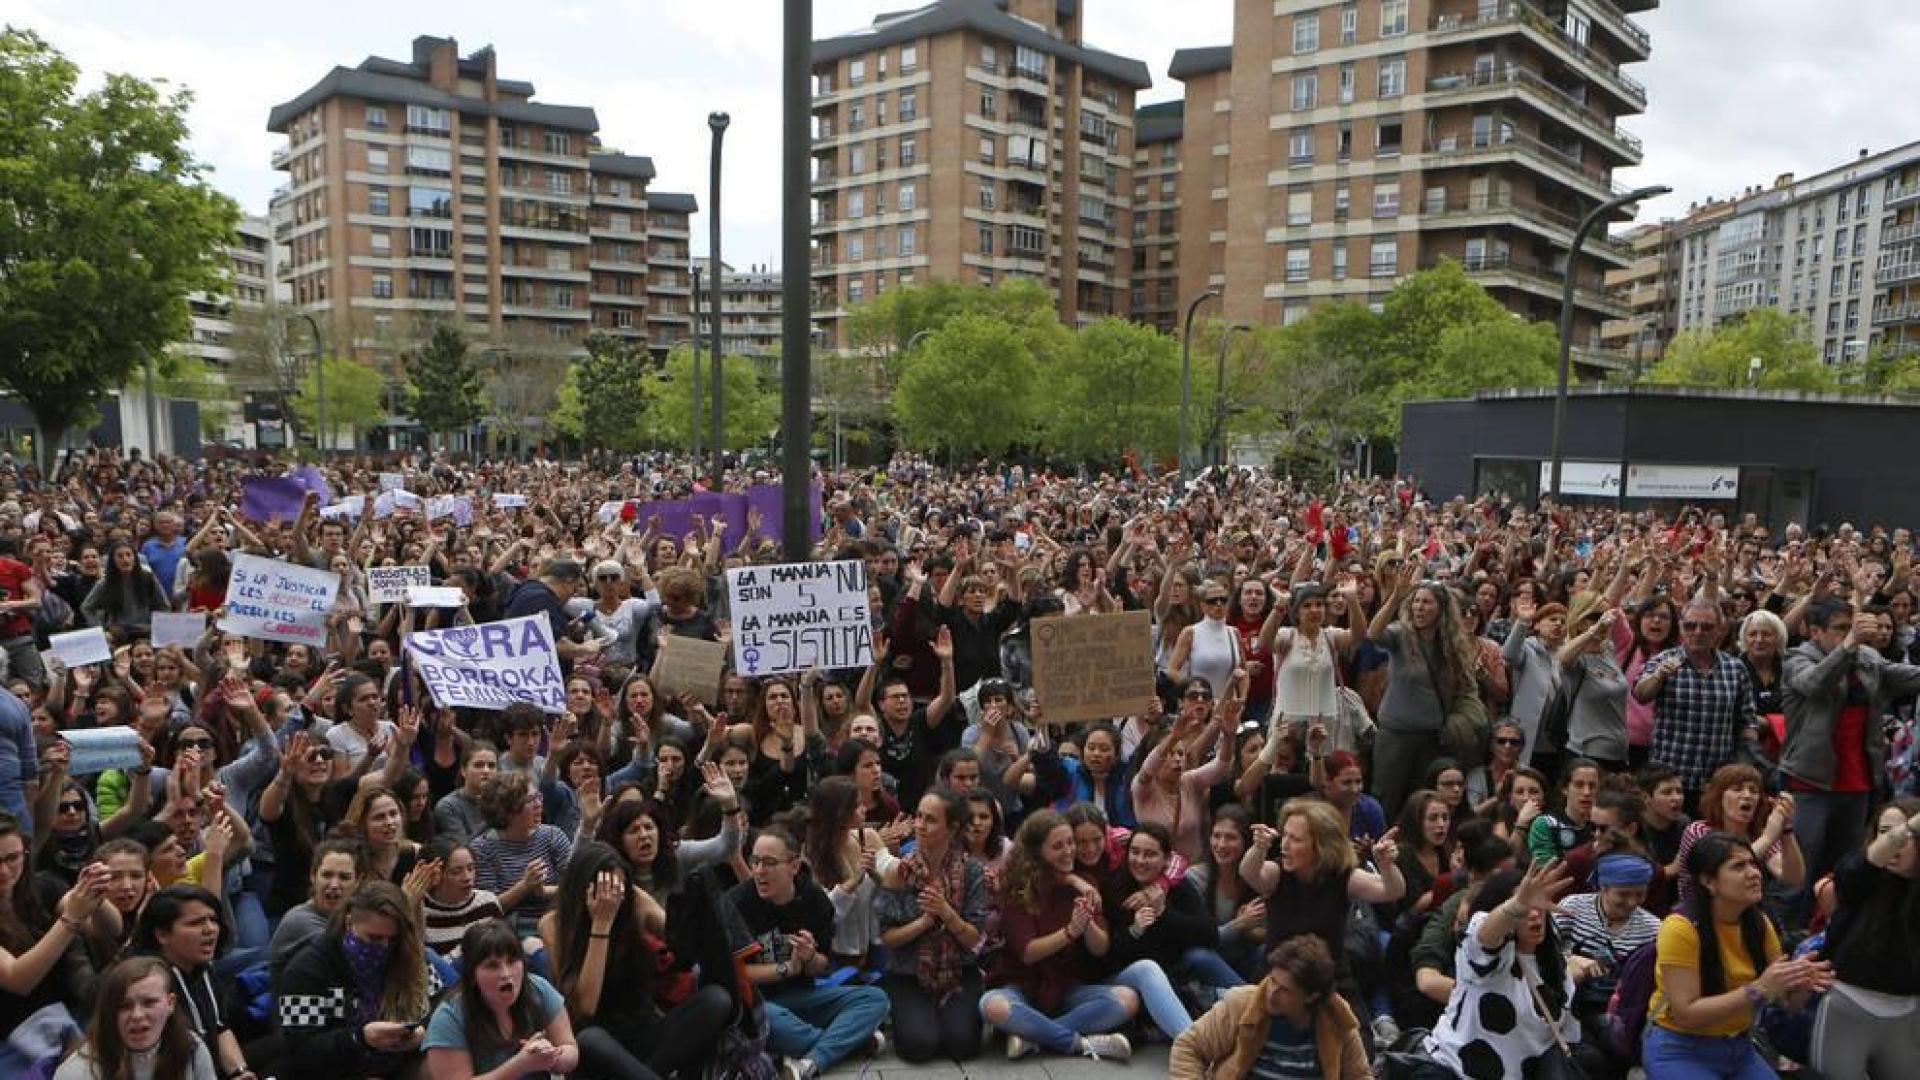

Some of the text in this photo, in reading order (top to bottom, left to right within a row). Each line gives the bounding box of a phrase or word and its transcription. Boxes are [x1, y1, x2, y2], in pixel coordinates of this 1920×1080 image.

[275, 576, 327, 596] JUSTICIA
[737, 570, 756, 586] LA
[739, 583, 815, 607] SON 5
[741, 615, 761, 630] LA
[422, 664, 560, 689] BORROKA
